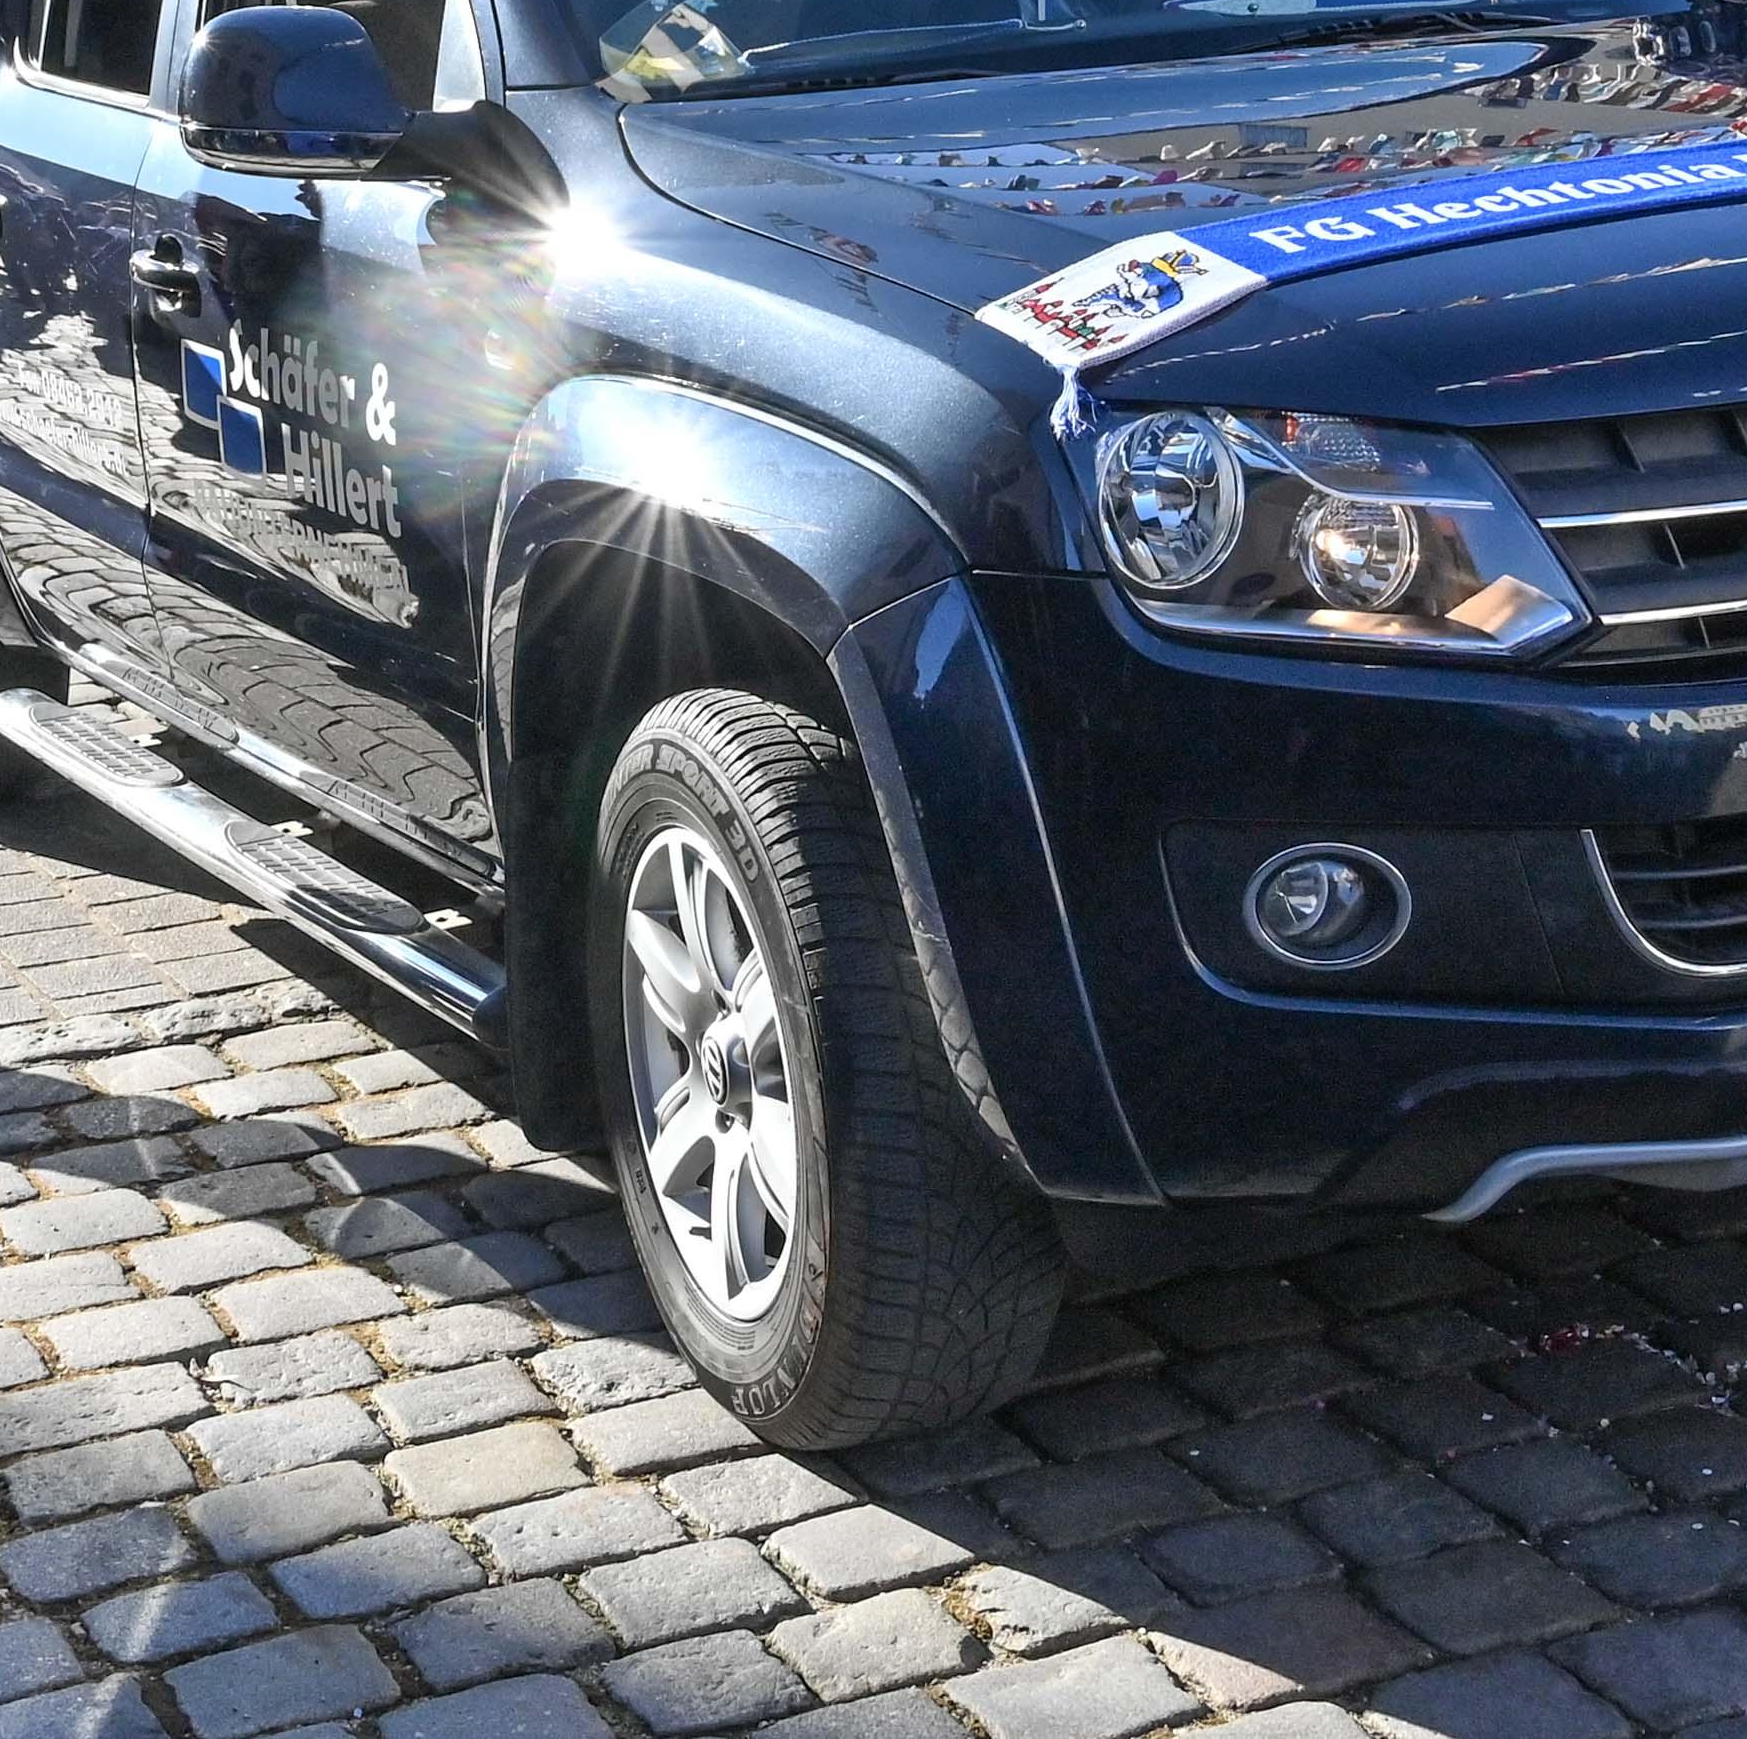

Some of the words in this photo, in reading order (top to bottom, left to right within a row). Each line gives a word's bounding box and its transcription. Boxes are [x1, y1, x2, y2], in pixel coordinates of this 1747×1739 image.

[1248, 215, 1376, 255] FG
[1365, 159, 1747, 230] Hechtonia
[227, 317, 356, 429] Schäfer
[365, 362, 397, 446] &
[280, 421, 402, 539] Hillert
